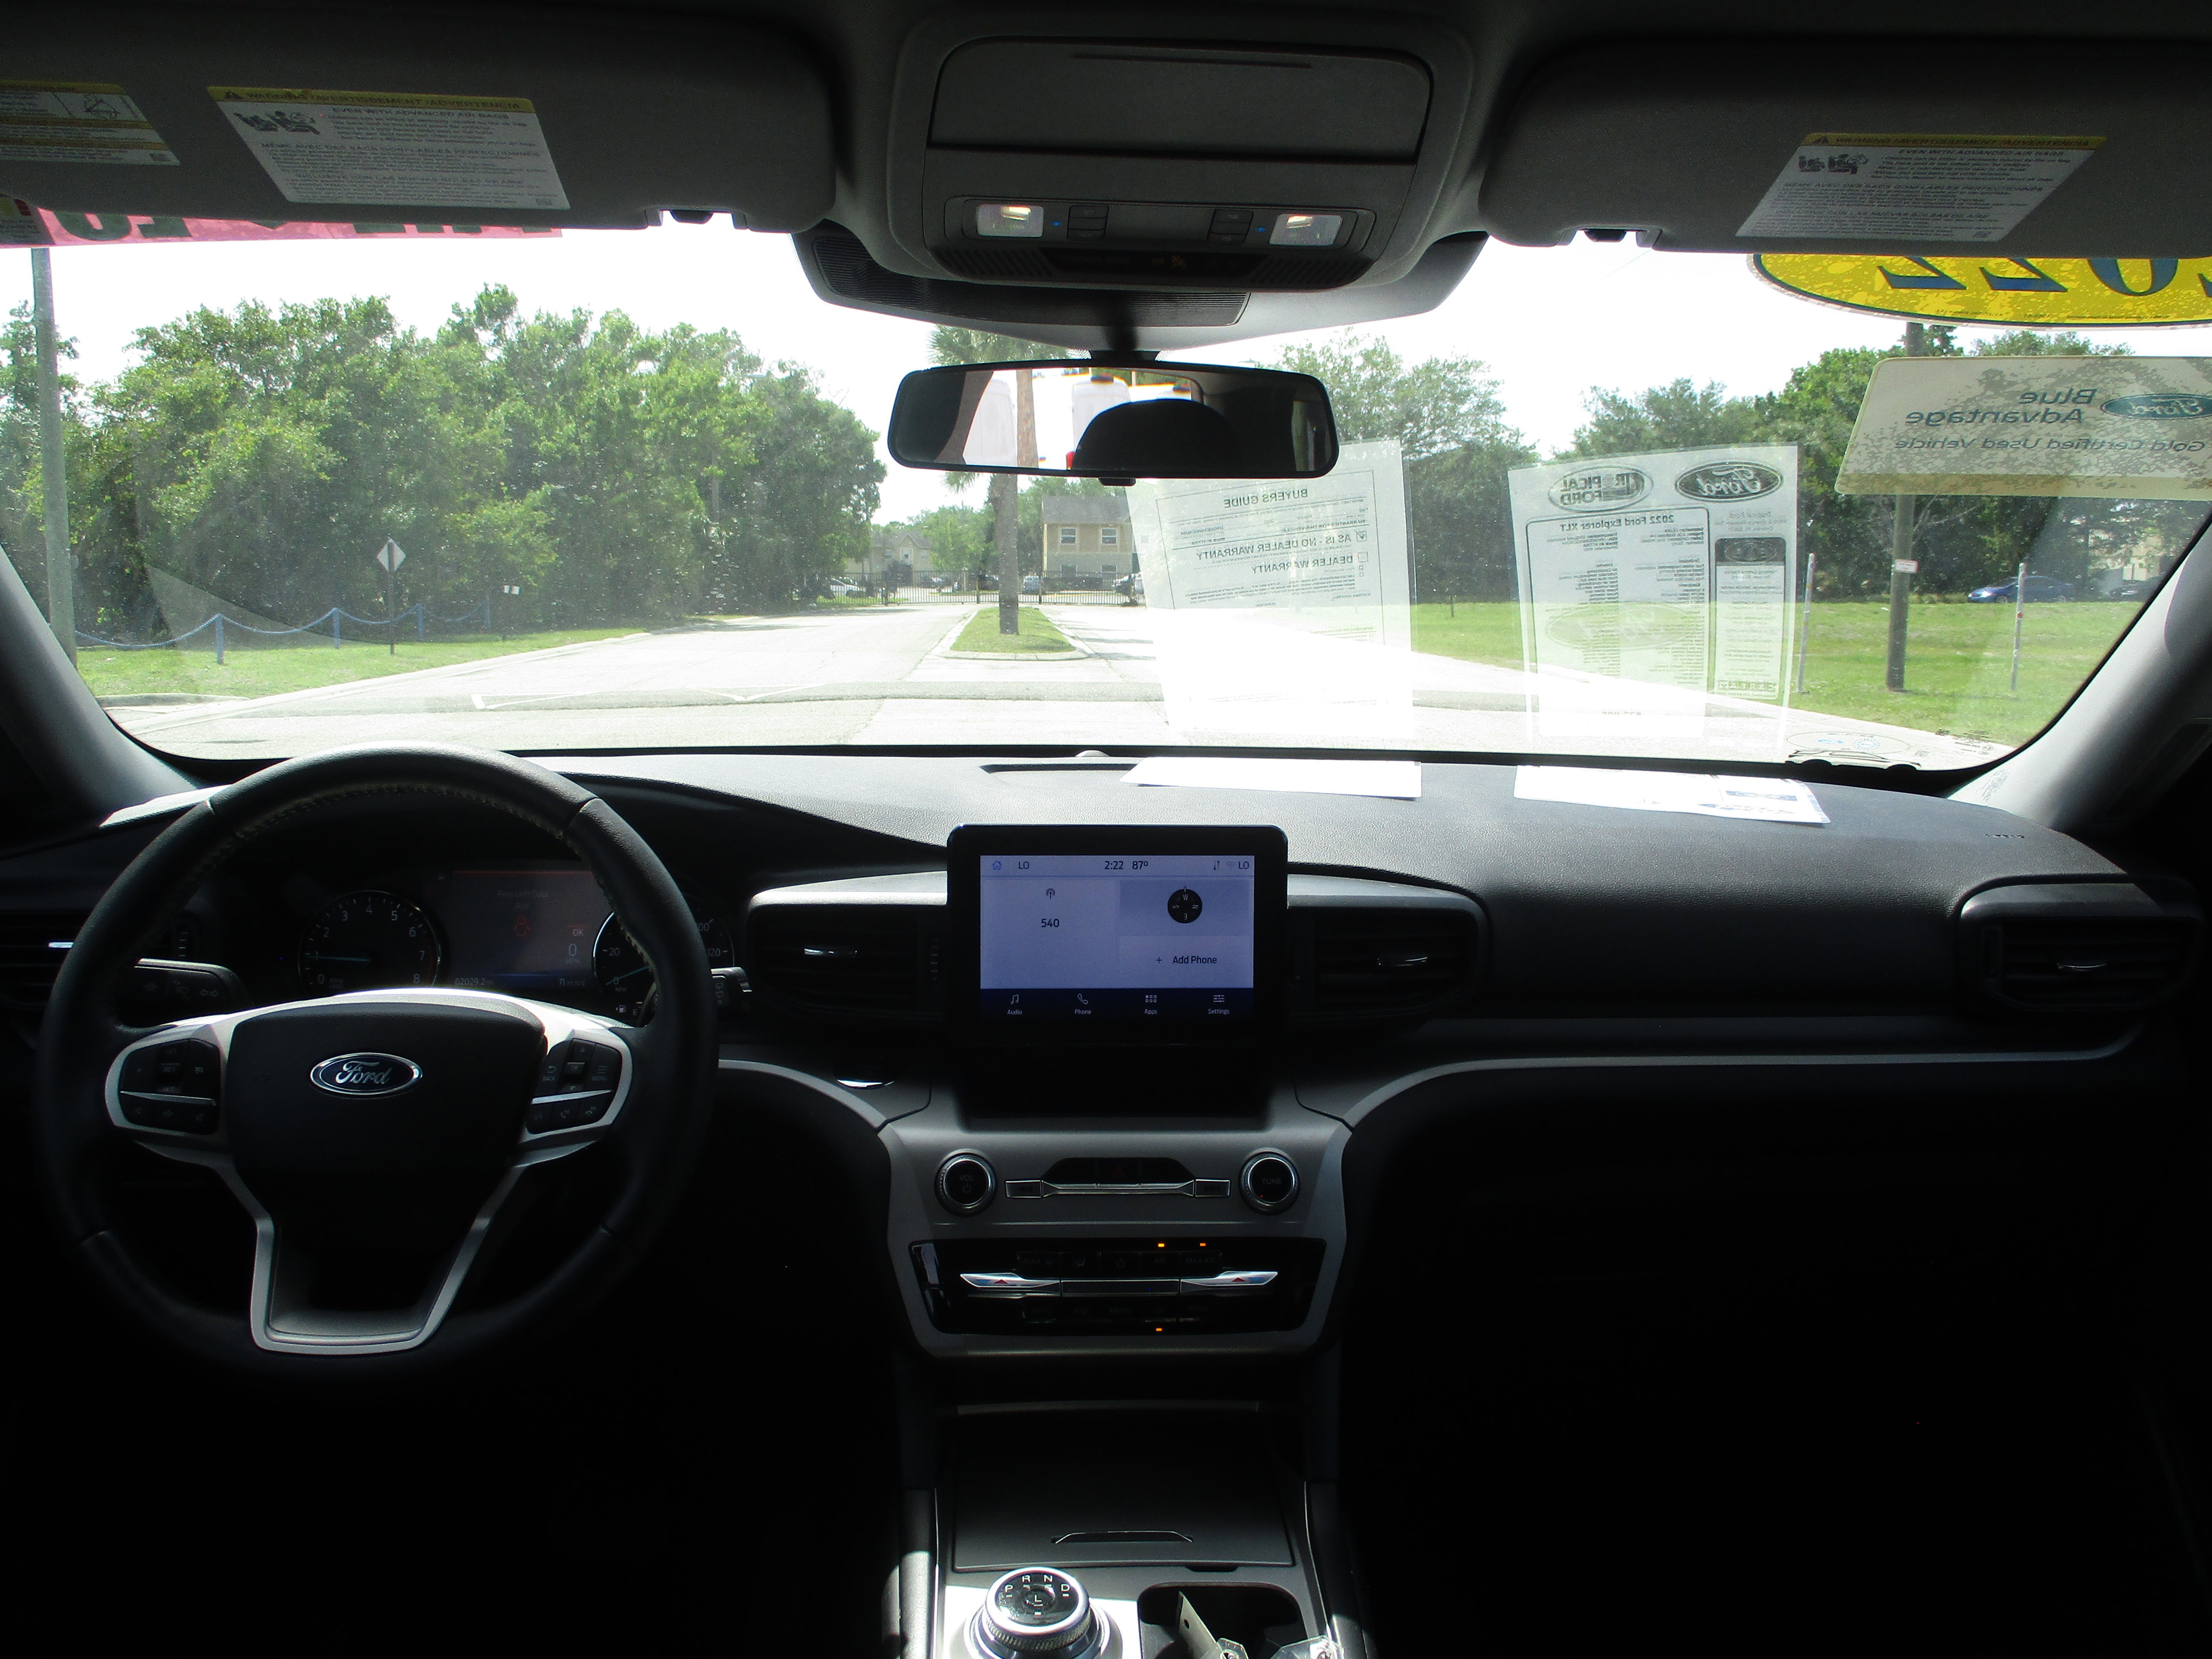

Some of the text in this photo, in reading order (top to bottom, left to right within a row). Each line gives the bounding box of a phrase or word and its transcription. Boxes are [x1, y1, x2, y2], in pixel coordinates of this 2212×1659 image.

[1018, 861, 1030, 869] LO
[1104, 860, 1124, 870] 2:22
[1238, 861, 1250, 869] LO
[366, 905, 373, 914] 4
[342, 911, 348, 921] 3
[391, 911, 398, 921] 5
[1041, 918, 1060, 928] 540
[323, 927, 330, 938] 2
[409, 927, 416, 937] 6
[572, 929, 584, 937] OK
[568, 943, 577, 956] 0
[609, 948, 620, 956] 20
[708, 948, 721, 957] 120
[419, 950, 425, 960] 7
[1173, 955, 1217, 964] Add Phone
[317, 974, 325, 984] 0
[413, 973, 420, 984] 8
[1005, 1584, 1014, 1592] P
[1061, 1583, 1070, 1592] D
[1034, 1594, 1042, 1602] L
